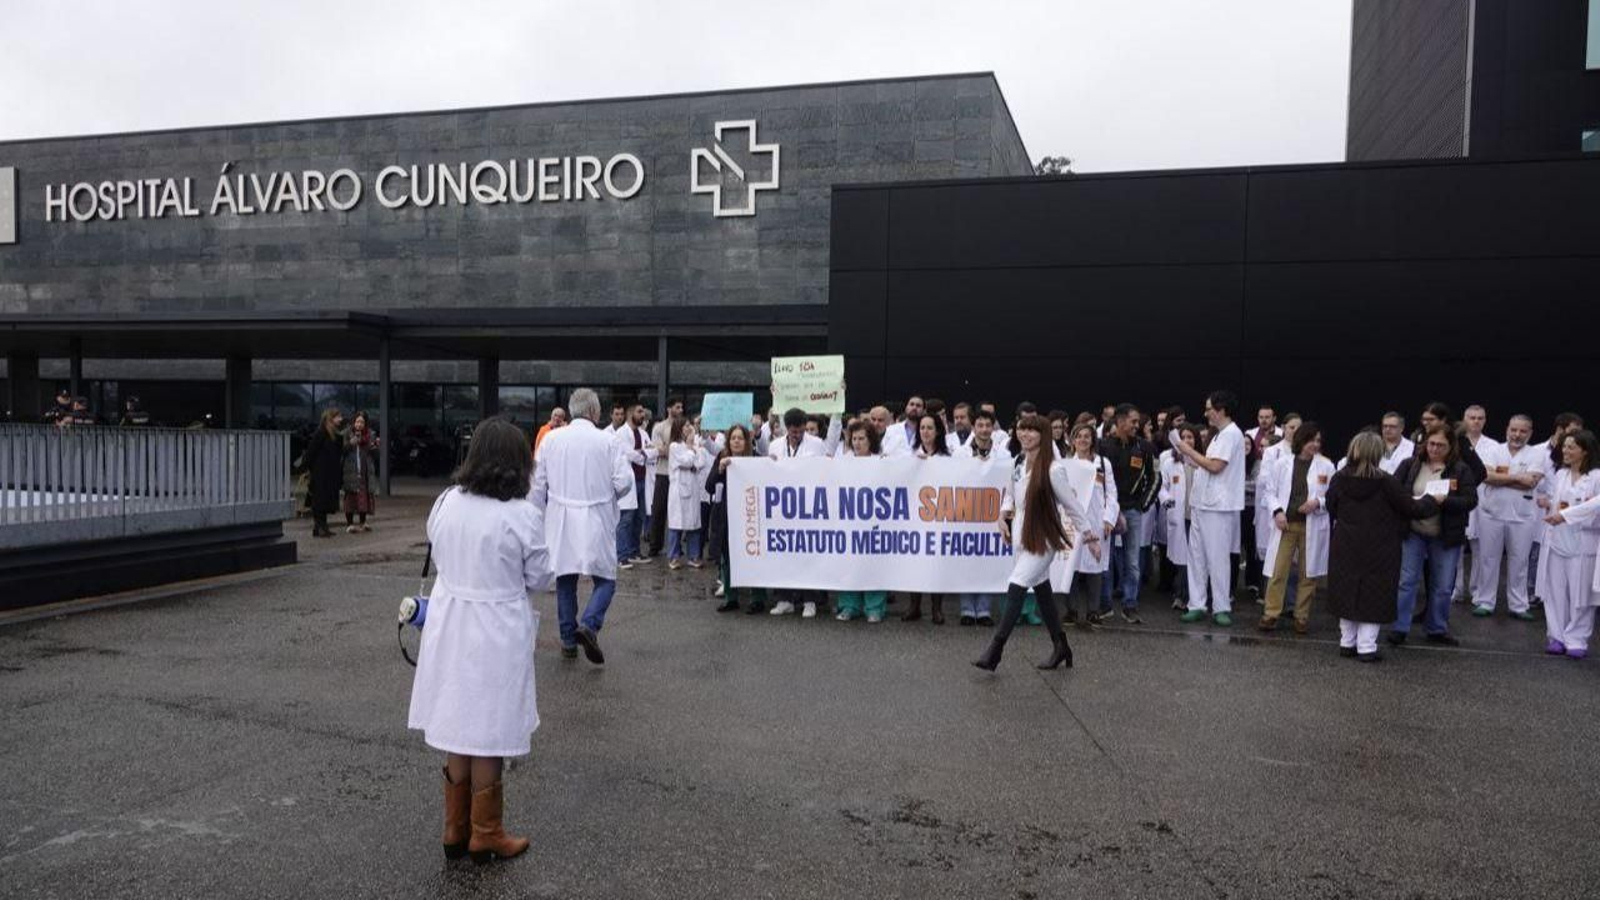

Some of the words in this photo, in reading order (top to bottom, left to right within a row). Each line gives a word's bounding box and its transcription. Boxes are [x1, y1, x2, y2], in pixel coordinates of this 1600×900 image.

[45, 176, 200, 222] HOSPITAL
[209, 161, 363, 216] ÁLVARO
[375, 152, 645, 208] CUNQUEIRO
[765, 486, 829, 520] POLA
[839, 486, 910, 521] NOSA
[918, 485, 1006, 523] SANID
[767, 529, 847, 554] ESTATUTO
[851, 525, 920, 555] MÉDICO
[925, 531, 936, 555] E
